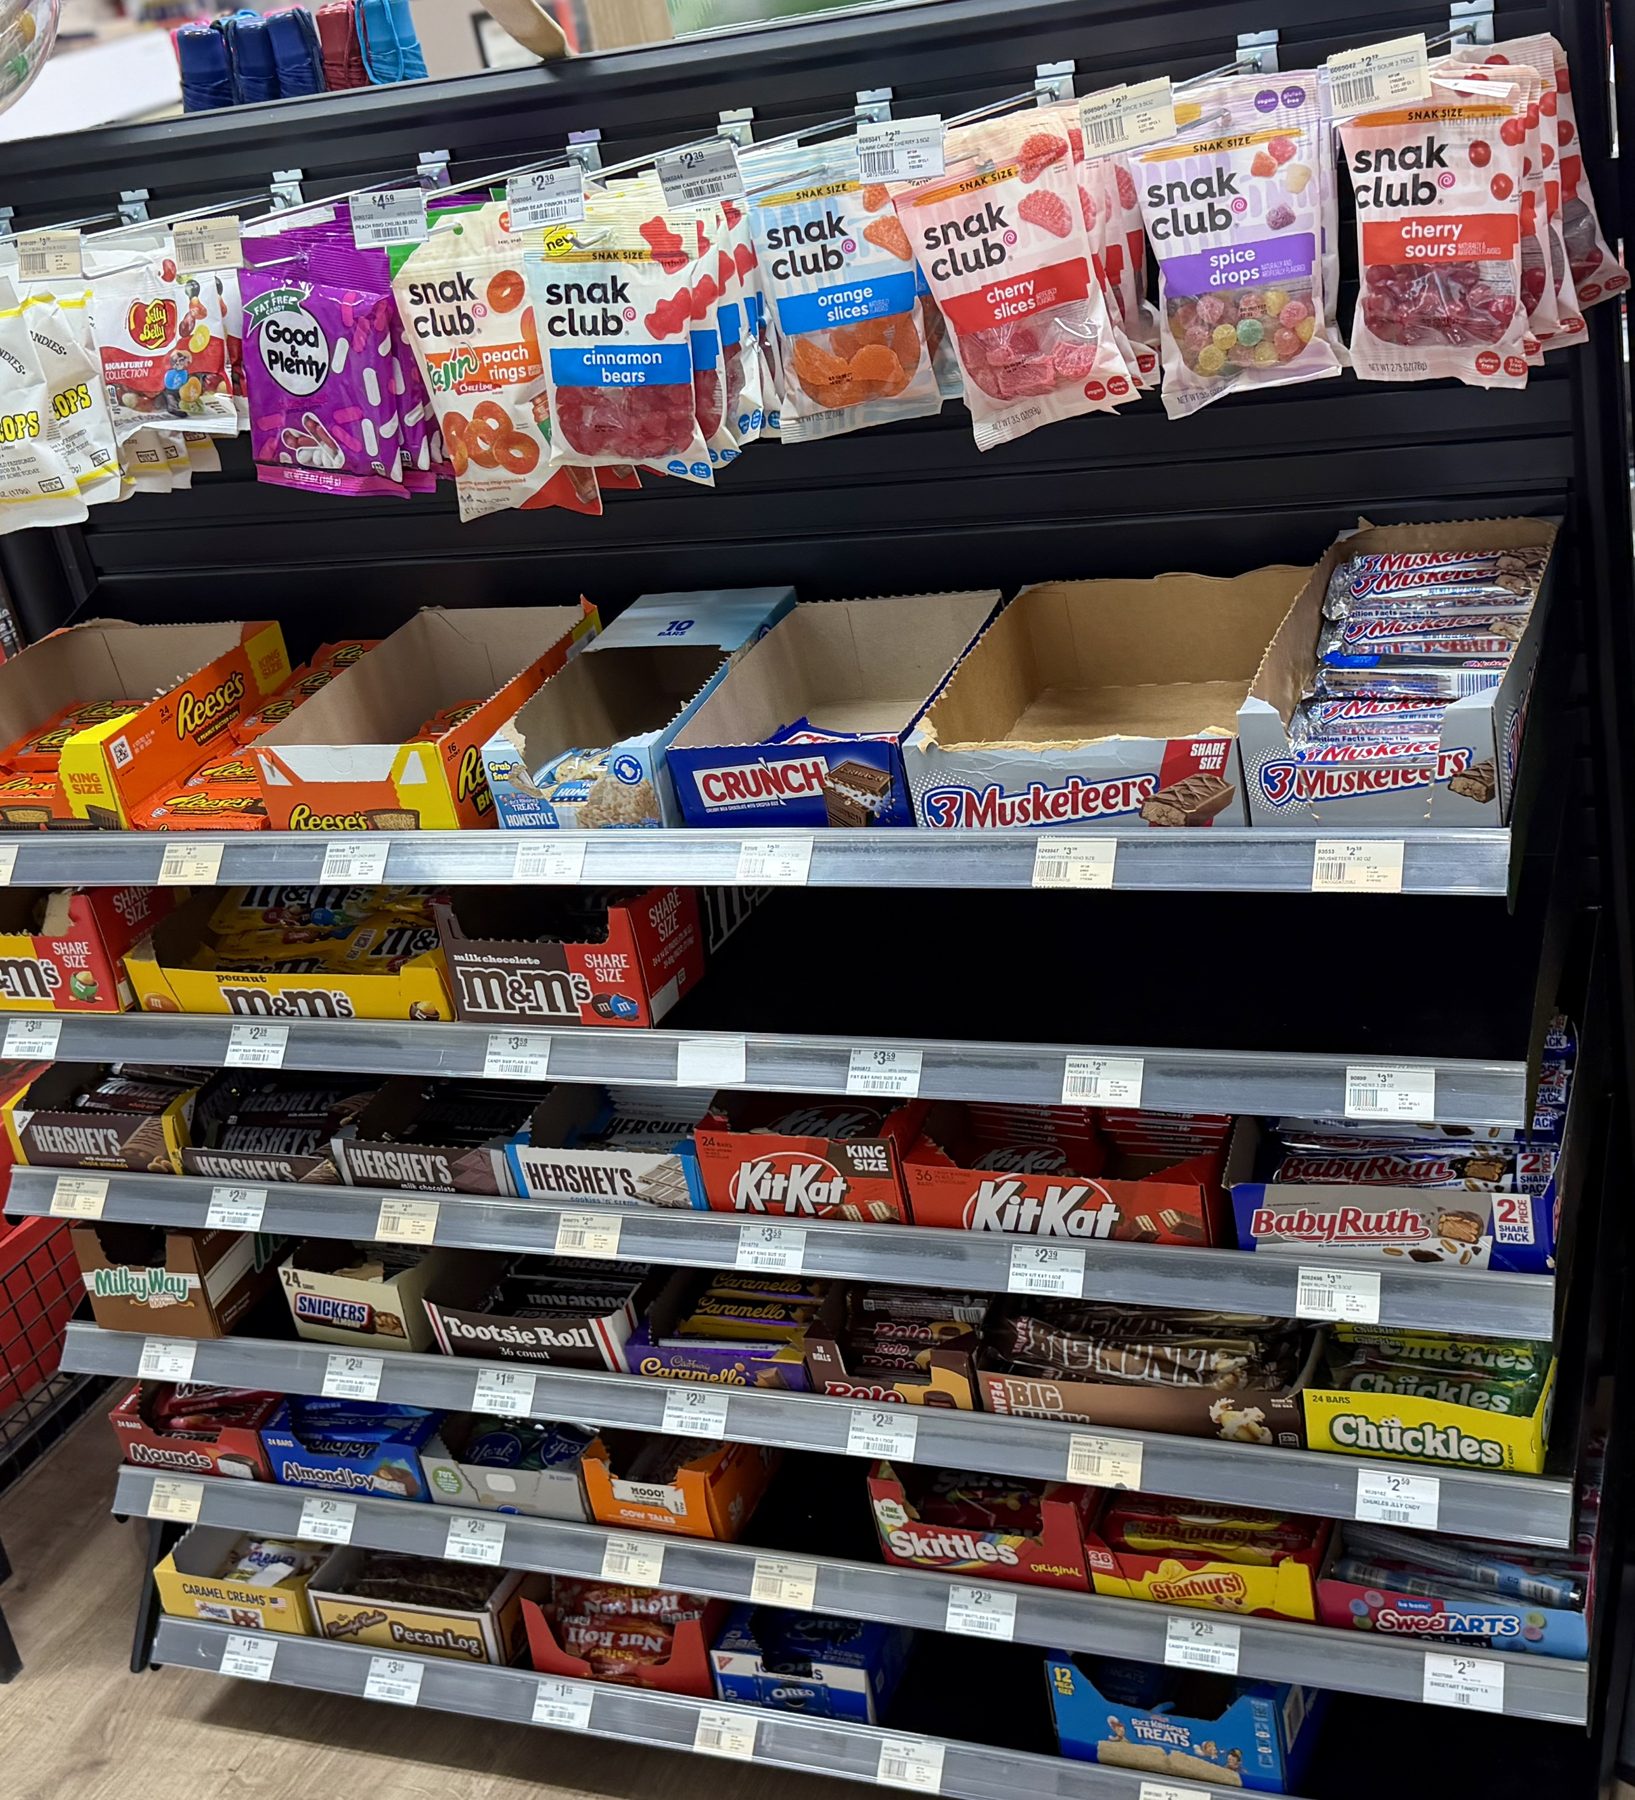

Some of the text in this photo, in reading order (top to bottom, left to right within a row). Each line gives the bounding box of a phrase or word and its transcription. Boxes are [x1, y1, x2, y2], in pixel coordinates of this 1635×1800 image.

[1407, 107, 1464, 121] SNAK SIZE
[1193, 136, 1251, 153] SNAK SIZE
[1353, 136, 1450, 173] snak
[959, 168, 1014, 192] SNAK SIZE
[1147, 167, 1241, 209] snak
[796, 183, 849, 200] SNAK SIZE
[1355, 173, 1438, 209] club
[766, 211, 849, 250] snak
[923, 202, 1010, 251] snak
[1151, 202, 1233, 241] club
[1401, 221, 1462, 242] cherry
[592, 250, 644, 260] SNAK SIZE
[931, 238, 1007, 281] club
[1209, 249, 1256, 270] spice
[1405, 242, 1457, 258] sours
[771, 244, 844, 280] club
[1209, 265, 1260, 287] drops
[409, 271, 479, 305] snak
[546, 275, 630, 305] snak
[818, 286, 873, 309] orange
[987, 279, 1035, 305] cherry
[144, 305, 168, 329] Jelly
[254, 303, 270, 316] FAT
[827, 302, 869, 323] slices
[994, 298, 1036, 321] slices
[413, 305, 475, 339] club
[548, 307, 623, 337] club
[140, 321, 166, 345] Belly
[265, 319, 319, 348] Good
[290, 344, 300, 357] &
[483, 346, 529, 368] peach
[582, 351, 662, 366] cinnamon
[105, 368, 149, 381] COLLECTION
[267, 351, 328, 384] Plenty
[488, 364, 527, 381] rings
[601, 367, 646, 383] bears
[666, 620, 695, 632] 10
[160, 671, 245, 741] 24 Reese's
[447, 742, 457, 753] 16
[1190, 743, 1226, 757] SHARE
[489, 761, 511, 772] Grab
[1199, 757, 1224, 770] SIZE
[68, 773, 100, 784] KING
[702, 759, 827, 802] CRUNCH
[1262, 763, 1294, 798] 3
[73, 784, 104, 795] SIZE
[511, 801, 541, 812] TREATS
[929, 775, 1155, 827] 3 Musketeers
[290, 803, 368, 830] Reese's
[506, 812, 555, 827] HOMESTYLE
[649, 886, 682, 928] SHARE
[657, 911, 679, 942] SIZE
[52, 941, 92, 956] SHARE
[454, 952, 540, 966] milk chocolate
[63, 955, 89, 969] SIZE
[584, 953, 630, 969] SHARE
[215, 974, 267, 984] peanut
[596, 967, 625, 983] SIZE
[222, 987, 354, 1018] m&m's
[458, 967, 591, 1017] m&m's
[31, 1124, 121, 1156] HERSHEY'S
[702, 1137, 716, 1147] 24
[846, 1145, 886, 1158] KING
[195, 1156, 293, 1183] HERSHEY'S
[348, 1148, 451, 1184] HERSHEY'S
[854, 1158, 889, 1172] SIZE
[1520, 1154, 1541, 1173] 2
[526, 1162, 637, 1197] HERSHEY'S
[915, 1168, 933, 1182] 36
[1520, 1175, 1550, 1184] SHARE
[418, 1184, 456, 1194] chocolate
[735, 1160, 848, 1214] KitKat
[971, 1180, 1120, 1238] KitKat
[1497, 1199, 1527, 1224] 2 PIECE
[1498, 1225, 1529, 1234] SHARE
[1500, 1233, 1530, 1242] PACK
[282, 1270, 301, 1288] 24
[712, 1272, 802, 1293] Caramello
[298, 1296, 367, 1323] SNICKERS
[698, 1297, 785, 1320] Caramello
[444, 1315, 594, 1348] Tootsie Roll
[876, 1321, 933, 1340] Rolo
[499, 1346, 550, 1360] 36 count
[876, 1342, 910, 1355] Rolo
[640, 1357, 746, 1386] Caramello
[670, 1355, 710, 1372] Cadbury
[825, 1381, 904, 1403] Rolo
[1006, 1379, 1063, 1411] BIG
[1312, 1394, 1350, 1405] 24 BARS
[130, 1443, 211, 1469] Mounds
[283, 1462, 345, 1482] Almond
[619, 1508, 646, 1519] COW
[888, 1530, 1019, 1566] Skittles
[1089, 1552, 1111, 1564] 36
[183, 1582, 266, 1607] CARAMEL CREAMS
[1150, 1573, 1241, 1601] Starburst
[568, 1627, 664, 1653] Nut Roll
[1055, 1667, 1072, 1682] 12
[771, 1687, 816, 1698] OREO
[1134, 1725, 1191, 1748] TREATS
